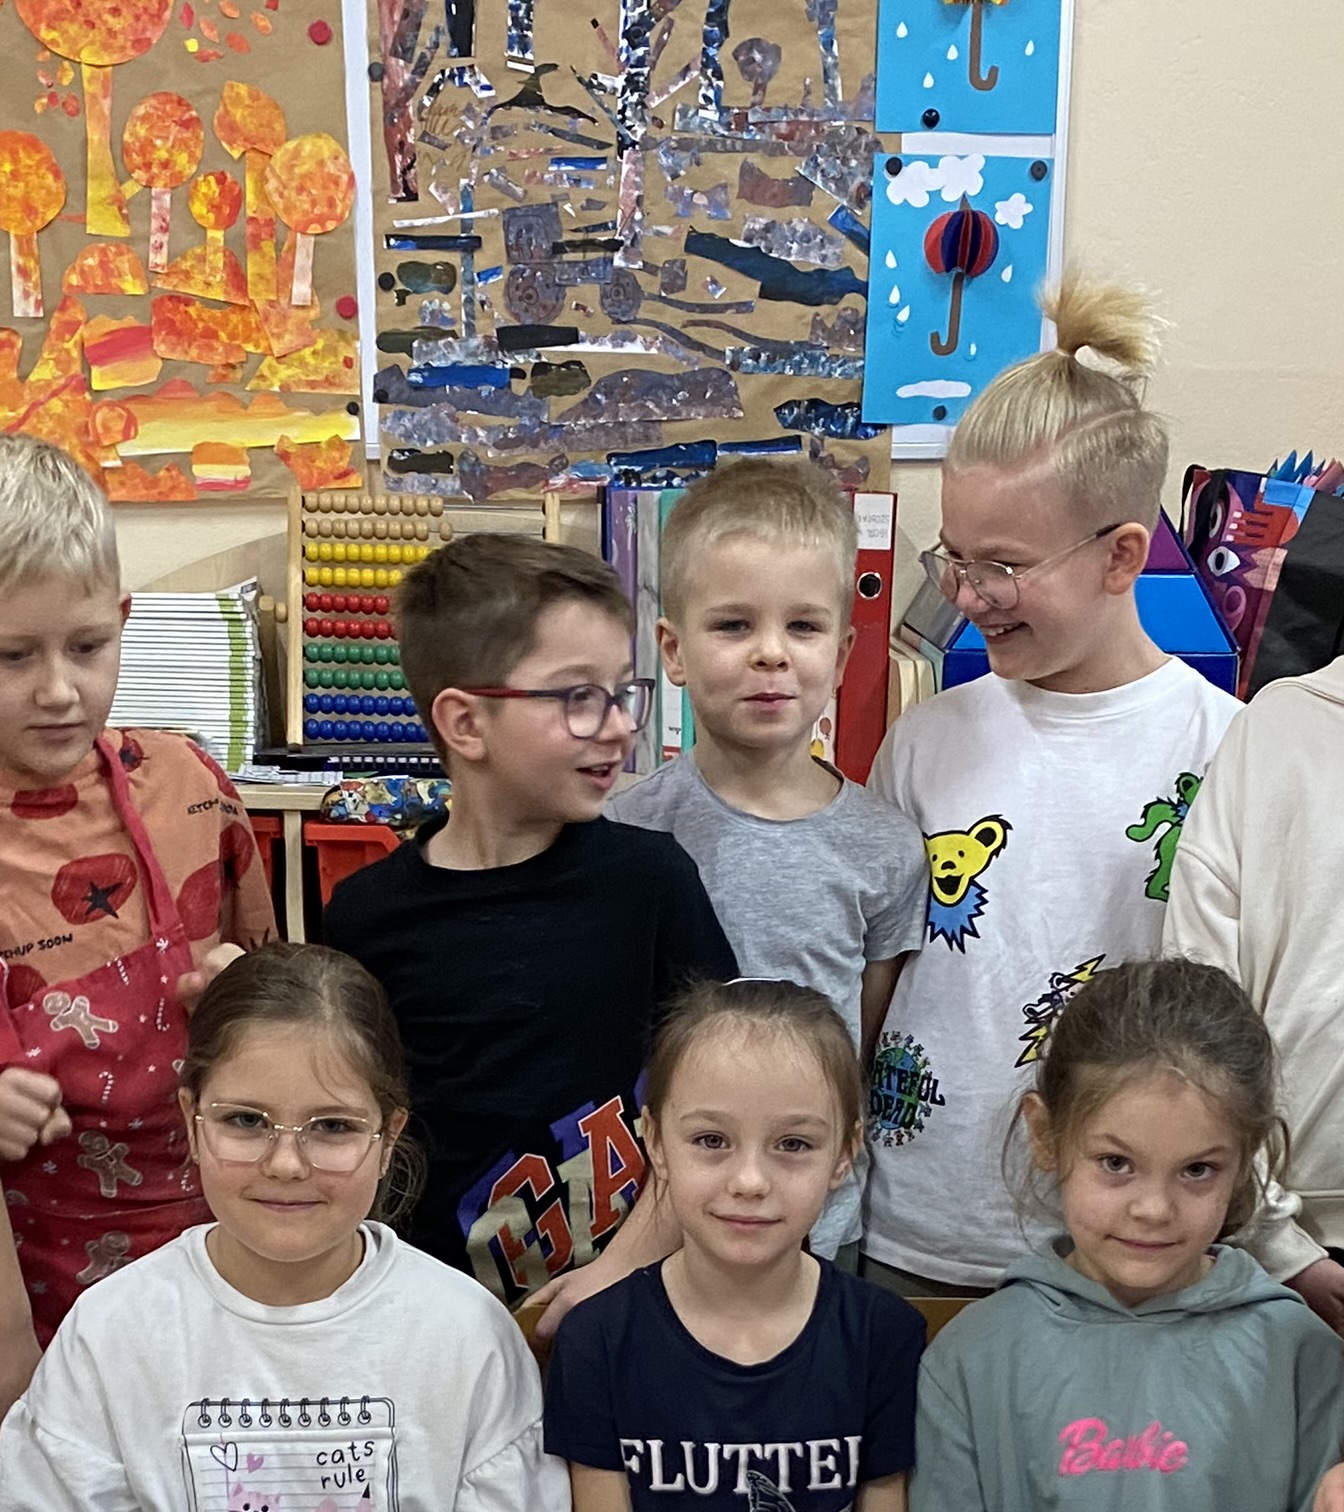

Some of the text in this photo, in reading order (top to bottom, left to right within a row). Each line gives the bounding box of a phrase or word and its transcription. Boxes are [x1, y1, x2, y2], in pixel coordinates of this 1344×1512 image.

[37, 933, 73, 951] SOON
[457, 1094, 651, 1305] GA
[316, 1439, 375, 1467] cats
[320, 1462, 366, 1490] rule
